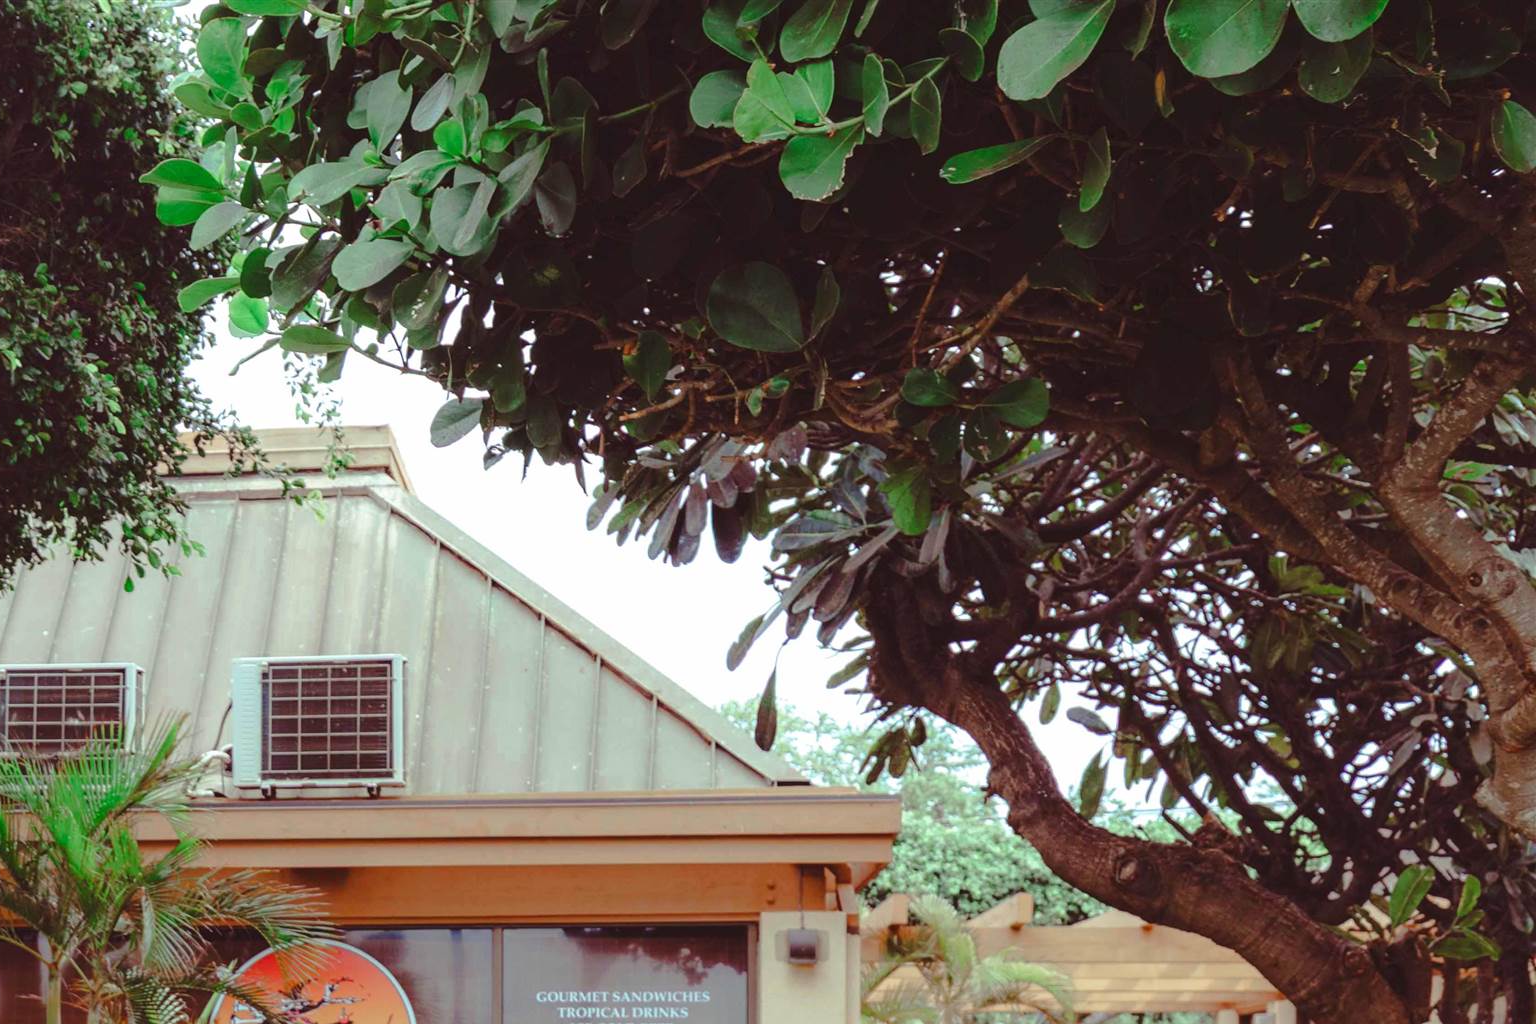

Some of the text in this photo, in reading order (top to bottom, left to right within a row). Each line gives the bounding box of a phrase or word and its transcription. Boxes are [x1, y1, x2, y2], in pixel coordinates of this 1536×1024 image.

[536, 991, 711, 1003] GOURMET SANDWICHES
[557, 1007, 690, 1019] TROPICAL DRINKS
